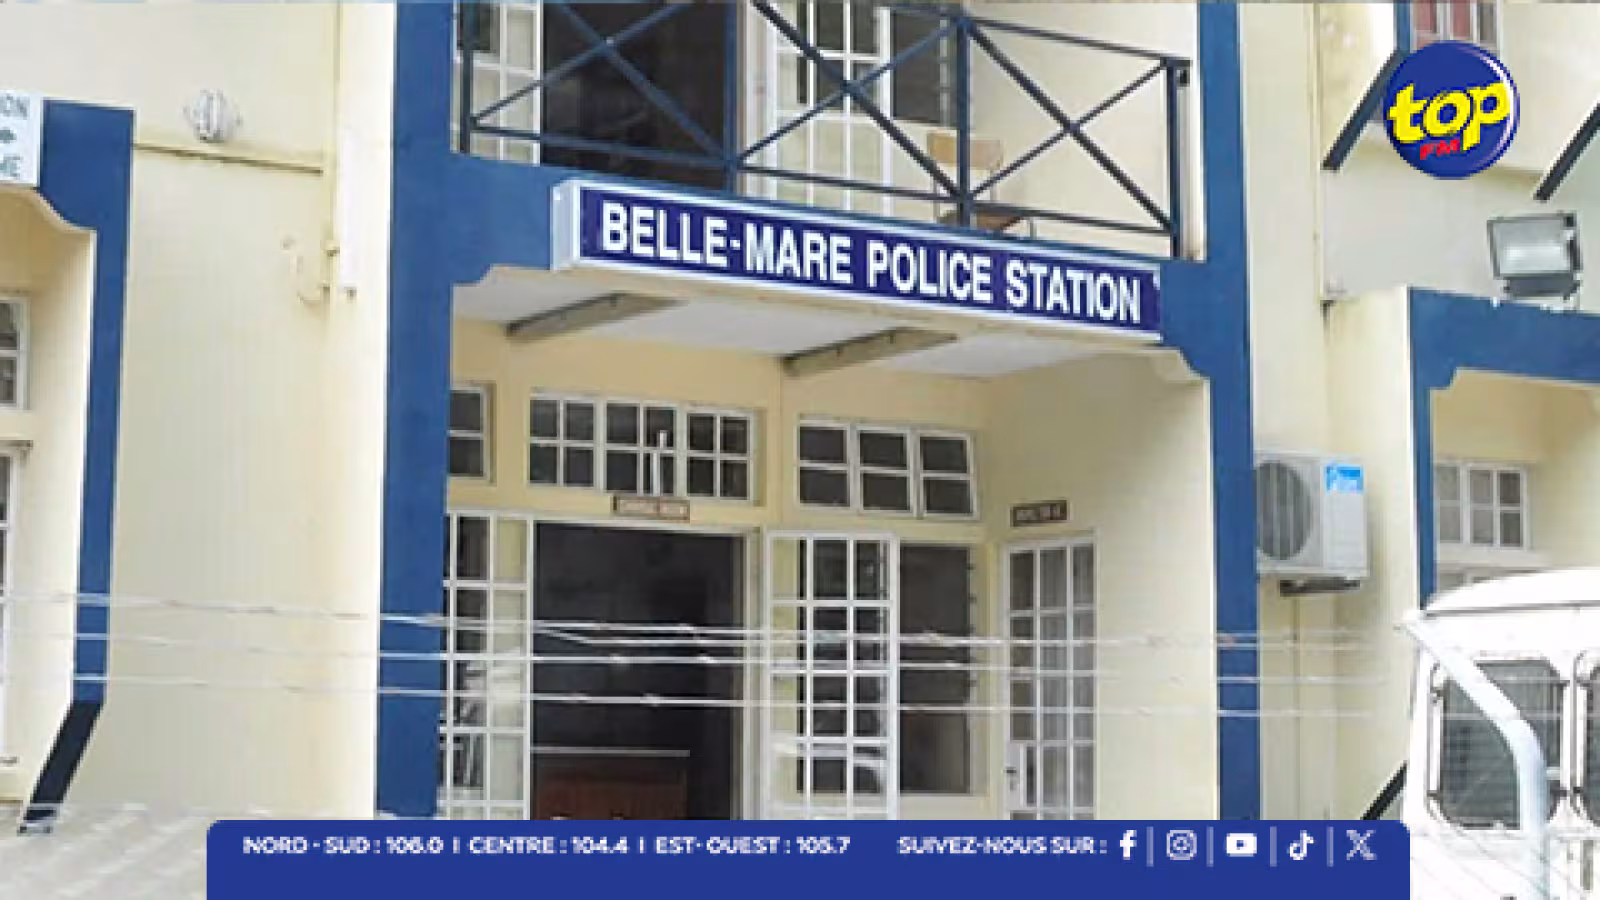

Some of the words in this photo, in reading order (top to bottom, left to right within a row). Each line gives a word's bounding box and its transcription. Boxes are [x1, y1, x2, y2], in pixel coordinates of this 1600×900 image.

[602, 199, 853, 284] BELLE-MARE
[866, 239, 993, 303] POLICE
[1006, 258, 1141, 324] STATION
